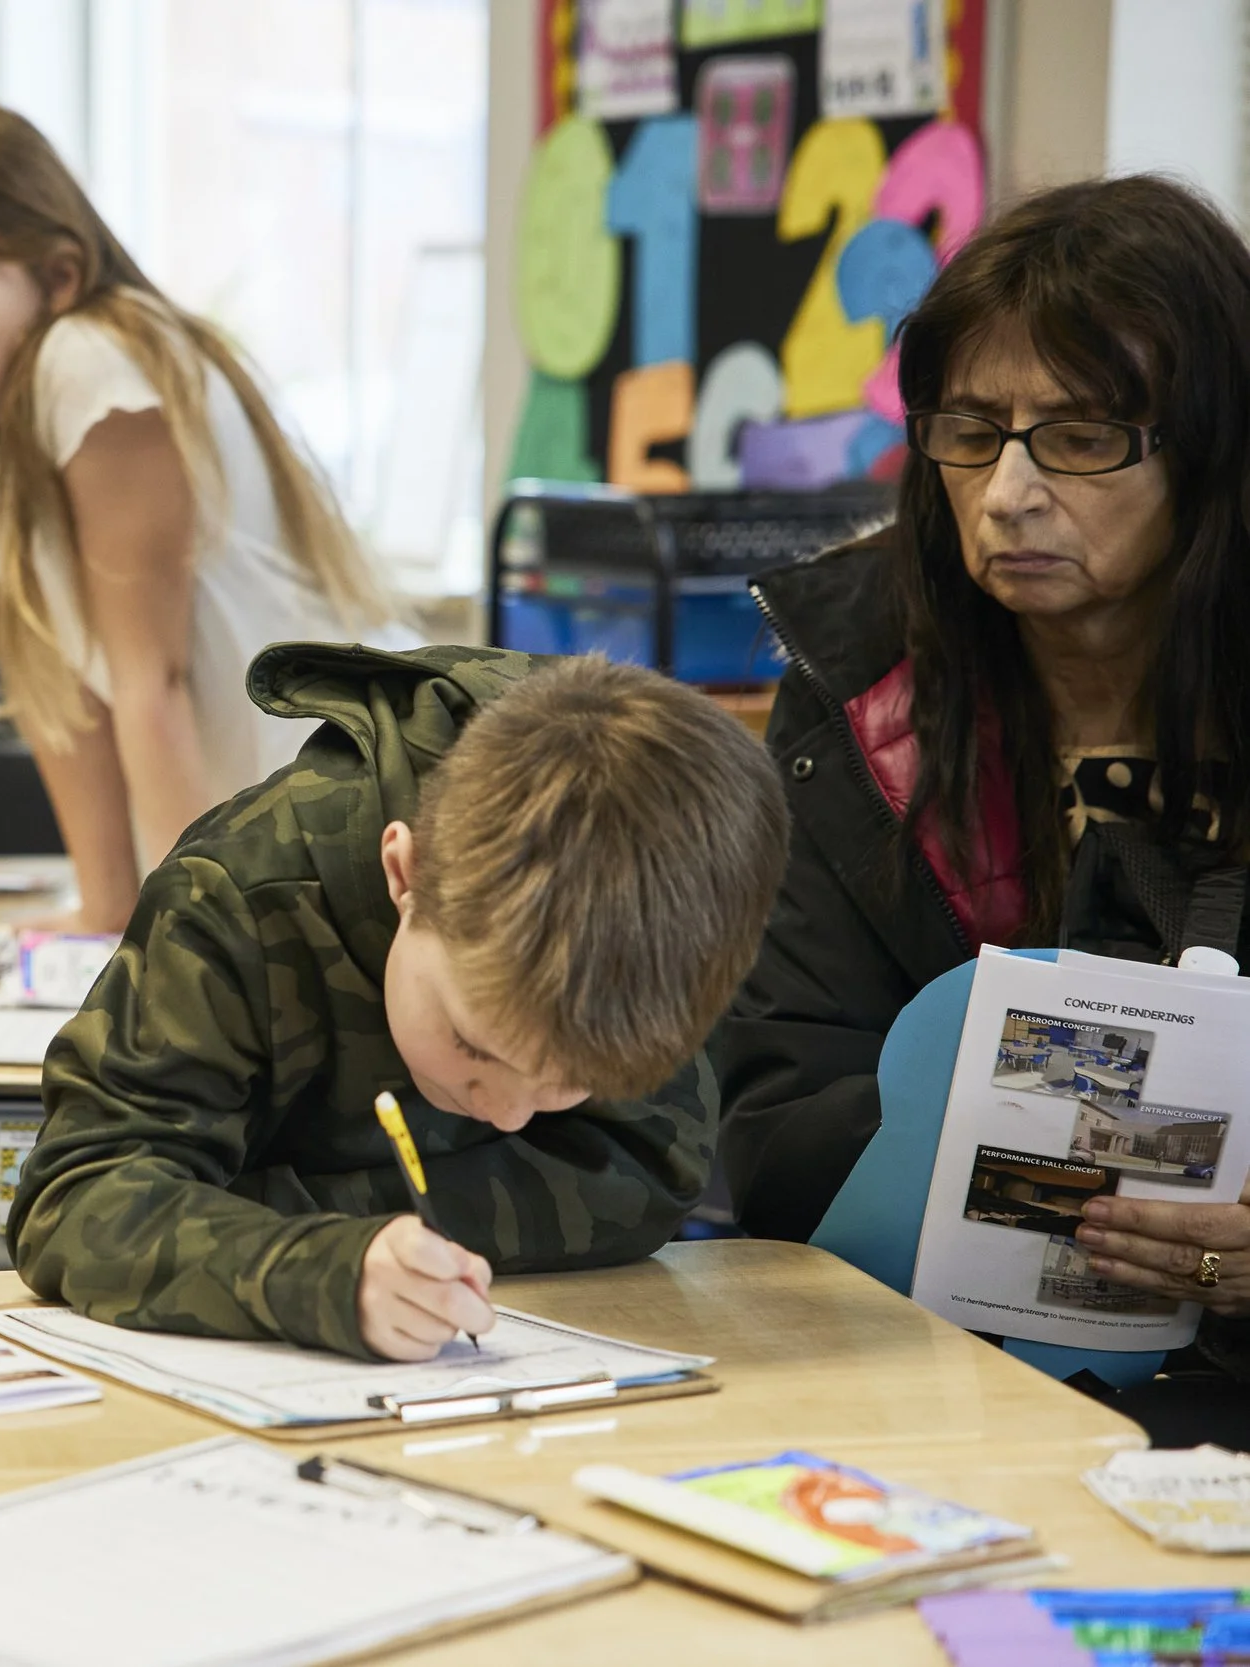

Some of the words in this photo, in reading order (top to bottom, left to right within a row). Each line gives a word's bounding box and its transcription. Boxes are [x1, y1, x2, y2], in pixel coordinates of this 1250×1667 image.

[1010, 1012, 1061, 1028] CLASSROOM
[1062, 1020, 1101, 1034] CONCEPT
[1064, 997, 1118, 1015] CONCEPT
[1121, 1005, 1196, 1026] RENDERINGS
[1140, 1105, 1184, 1118] ENTRANCE
[1184, 1111, 1225, 1122] CONCEPT
[980, 1149, 1041, 1166] PERFORMANCE
[1041, 1159, 1063, 1169] HALL
[1063, 1163, 1102, 1175] CONCEPT
[951, 1294, 966, 1304] Visit
[966, 1297, 1049, 1319] heritageweb.org/strong
[1059, 1313, 1077, 1322] learn
[1077, 1317, 1097, 1325] more
[1097, 1319, 1119, 1328] about
